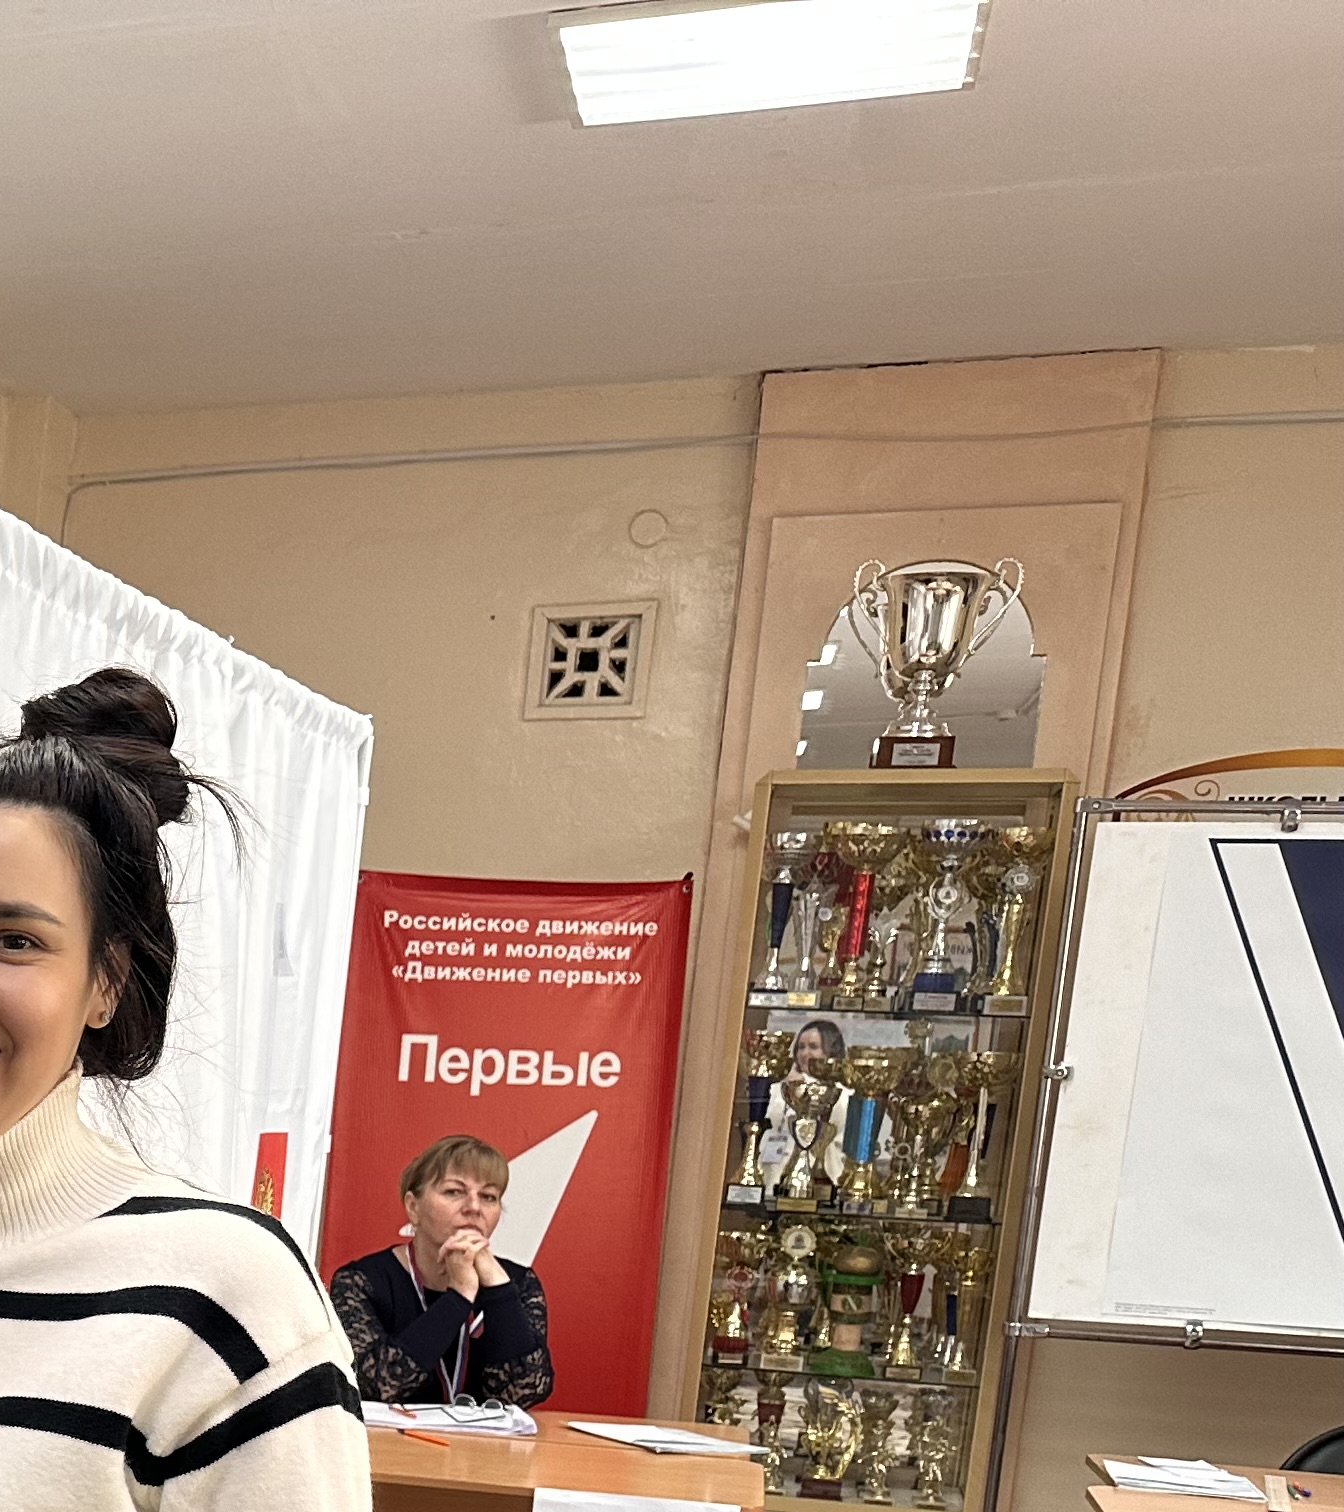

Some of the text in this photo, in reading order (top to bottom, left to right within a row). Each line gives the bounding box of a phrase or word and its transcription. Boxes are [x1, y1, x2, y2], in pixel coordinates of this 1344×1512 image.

[384, 910, 658, 938] Российское движение
[404, 938, 631, 963] детей и молодёжи
[392, 962, 642, 988] «Движение первых»
[398, 1033, 621, 1096] Первые
